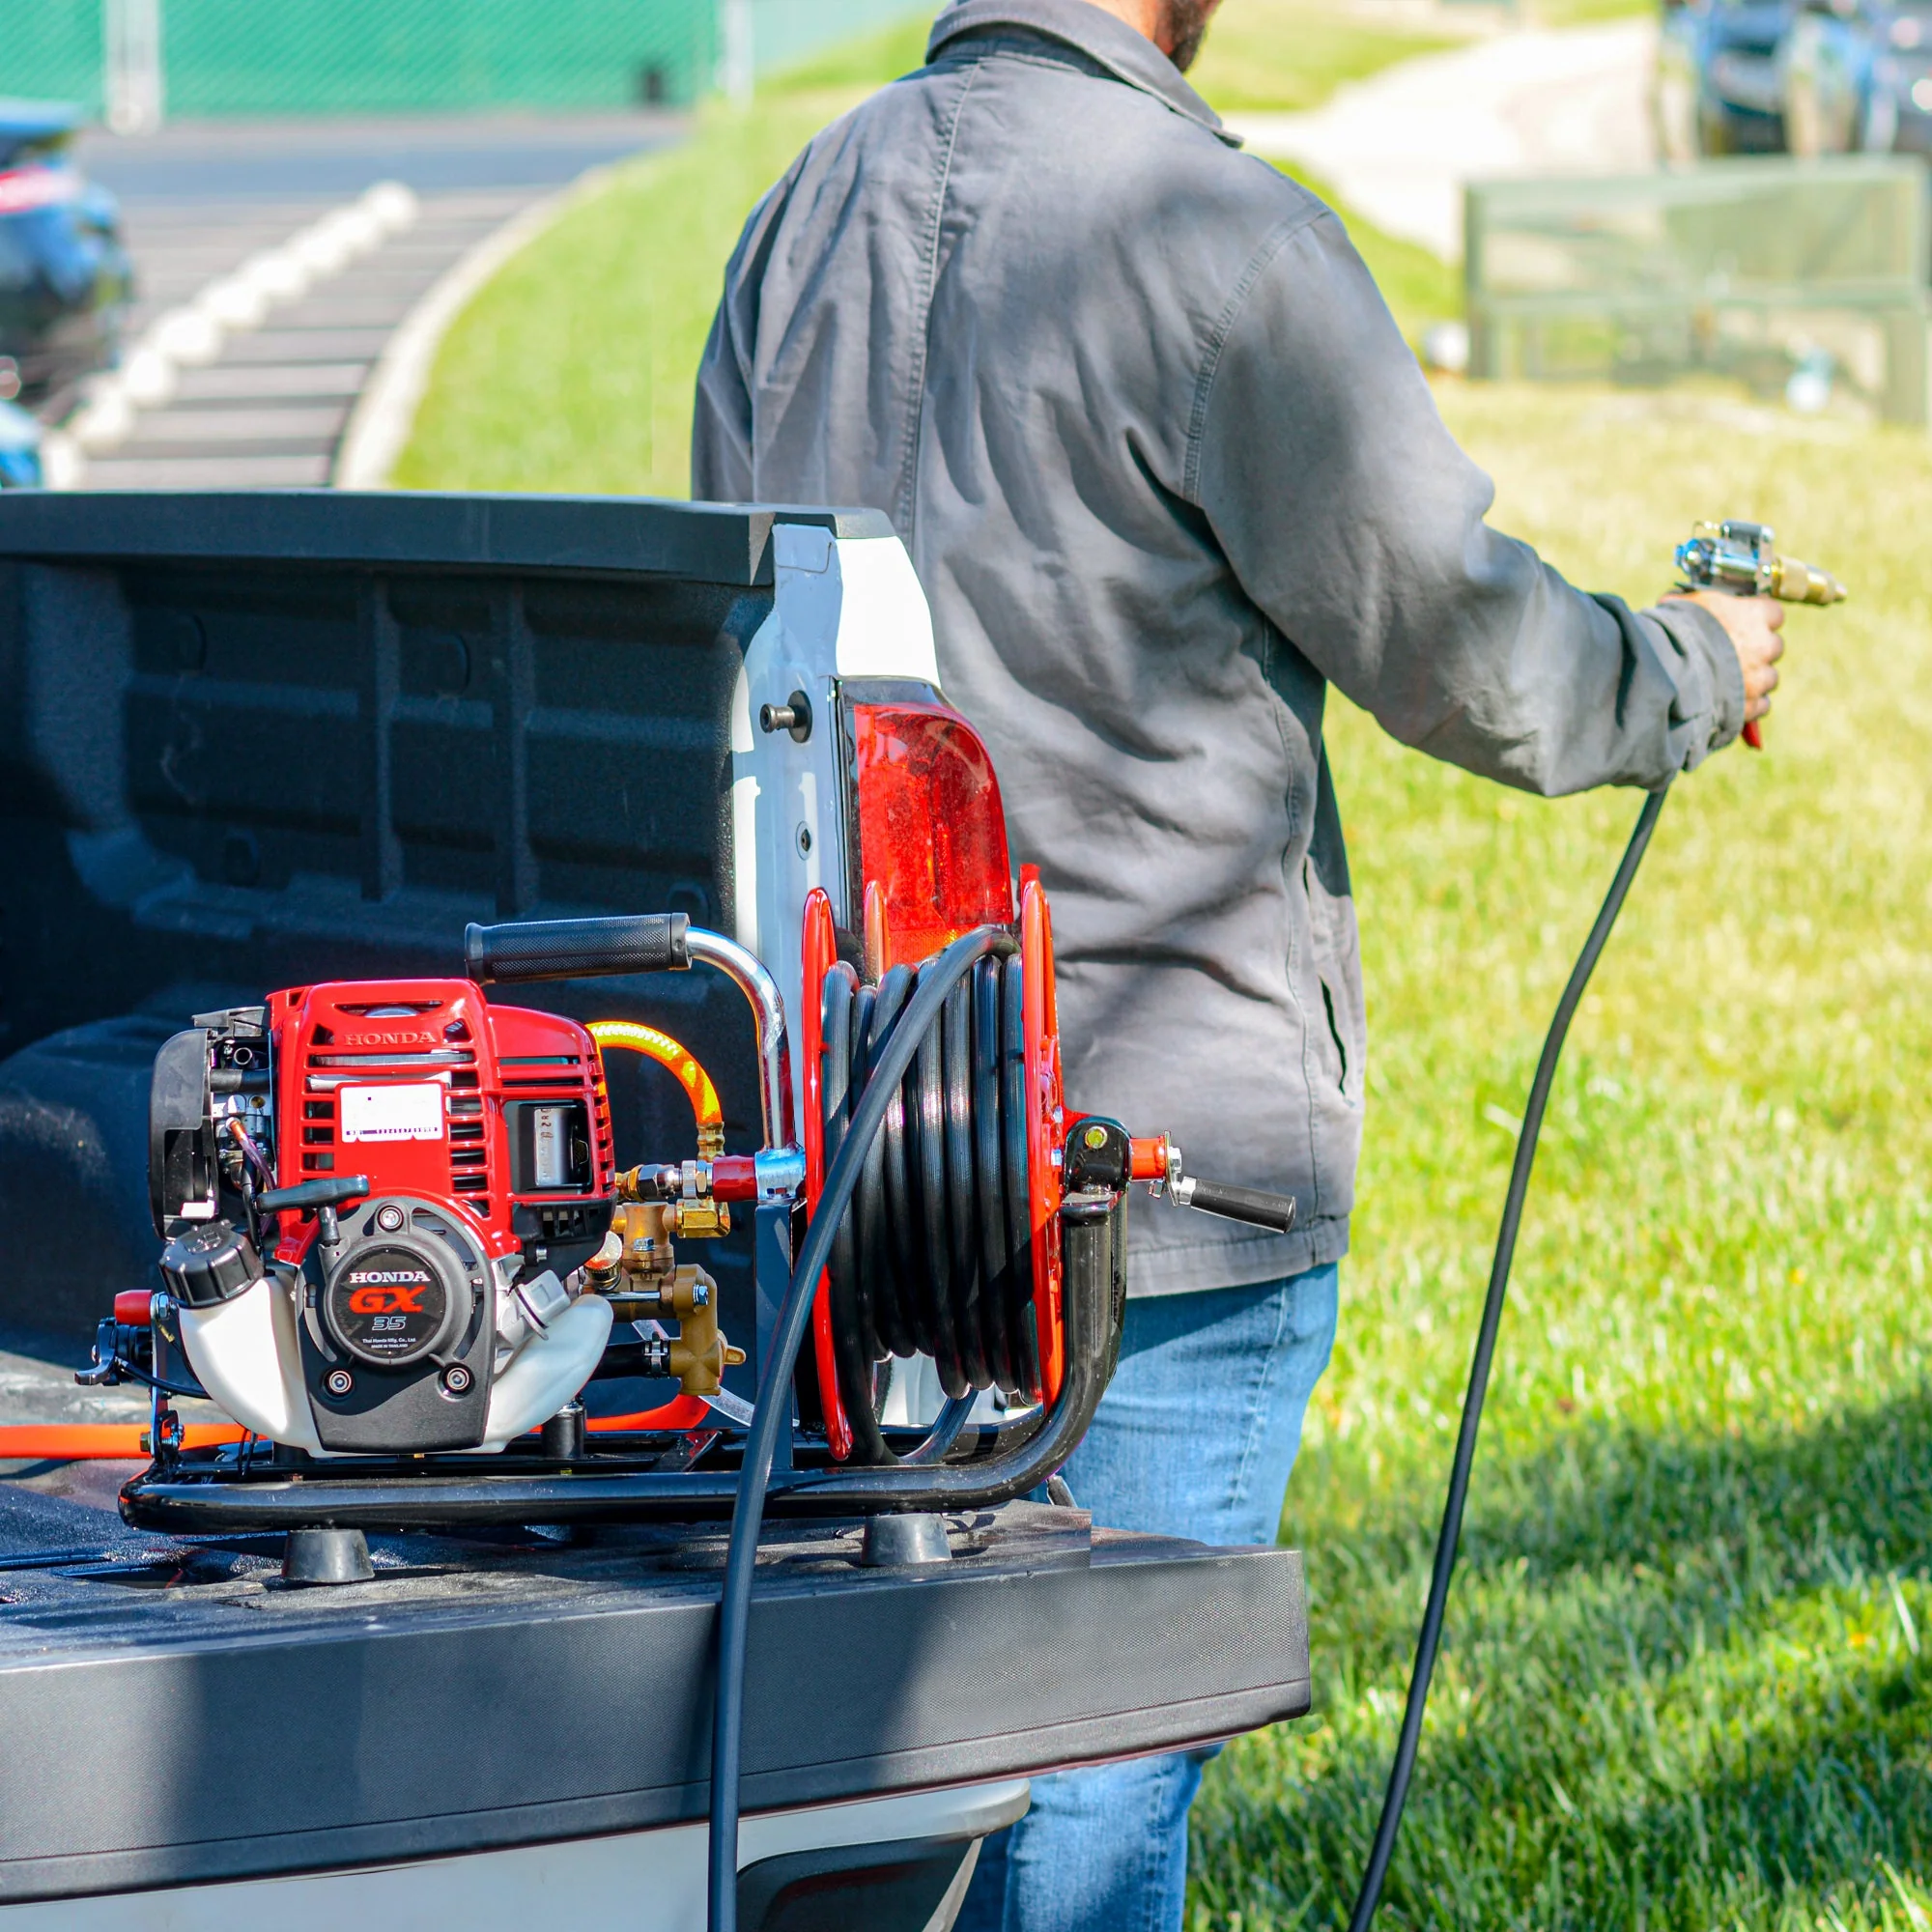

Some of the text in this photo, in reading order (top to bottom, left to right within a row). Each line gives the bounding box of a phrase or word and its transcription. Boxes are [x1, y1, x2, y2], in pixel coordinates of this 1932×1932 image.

[344, 1032, 438, 1046] HONDA
[350, 1270, 431, 1283] HONDA
[349, 1286, 426, 1314] GX
[371, 1316, 407, 1331] 35
